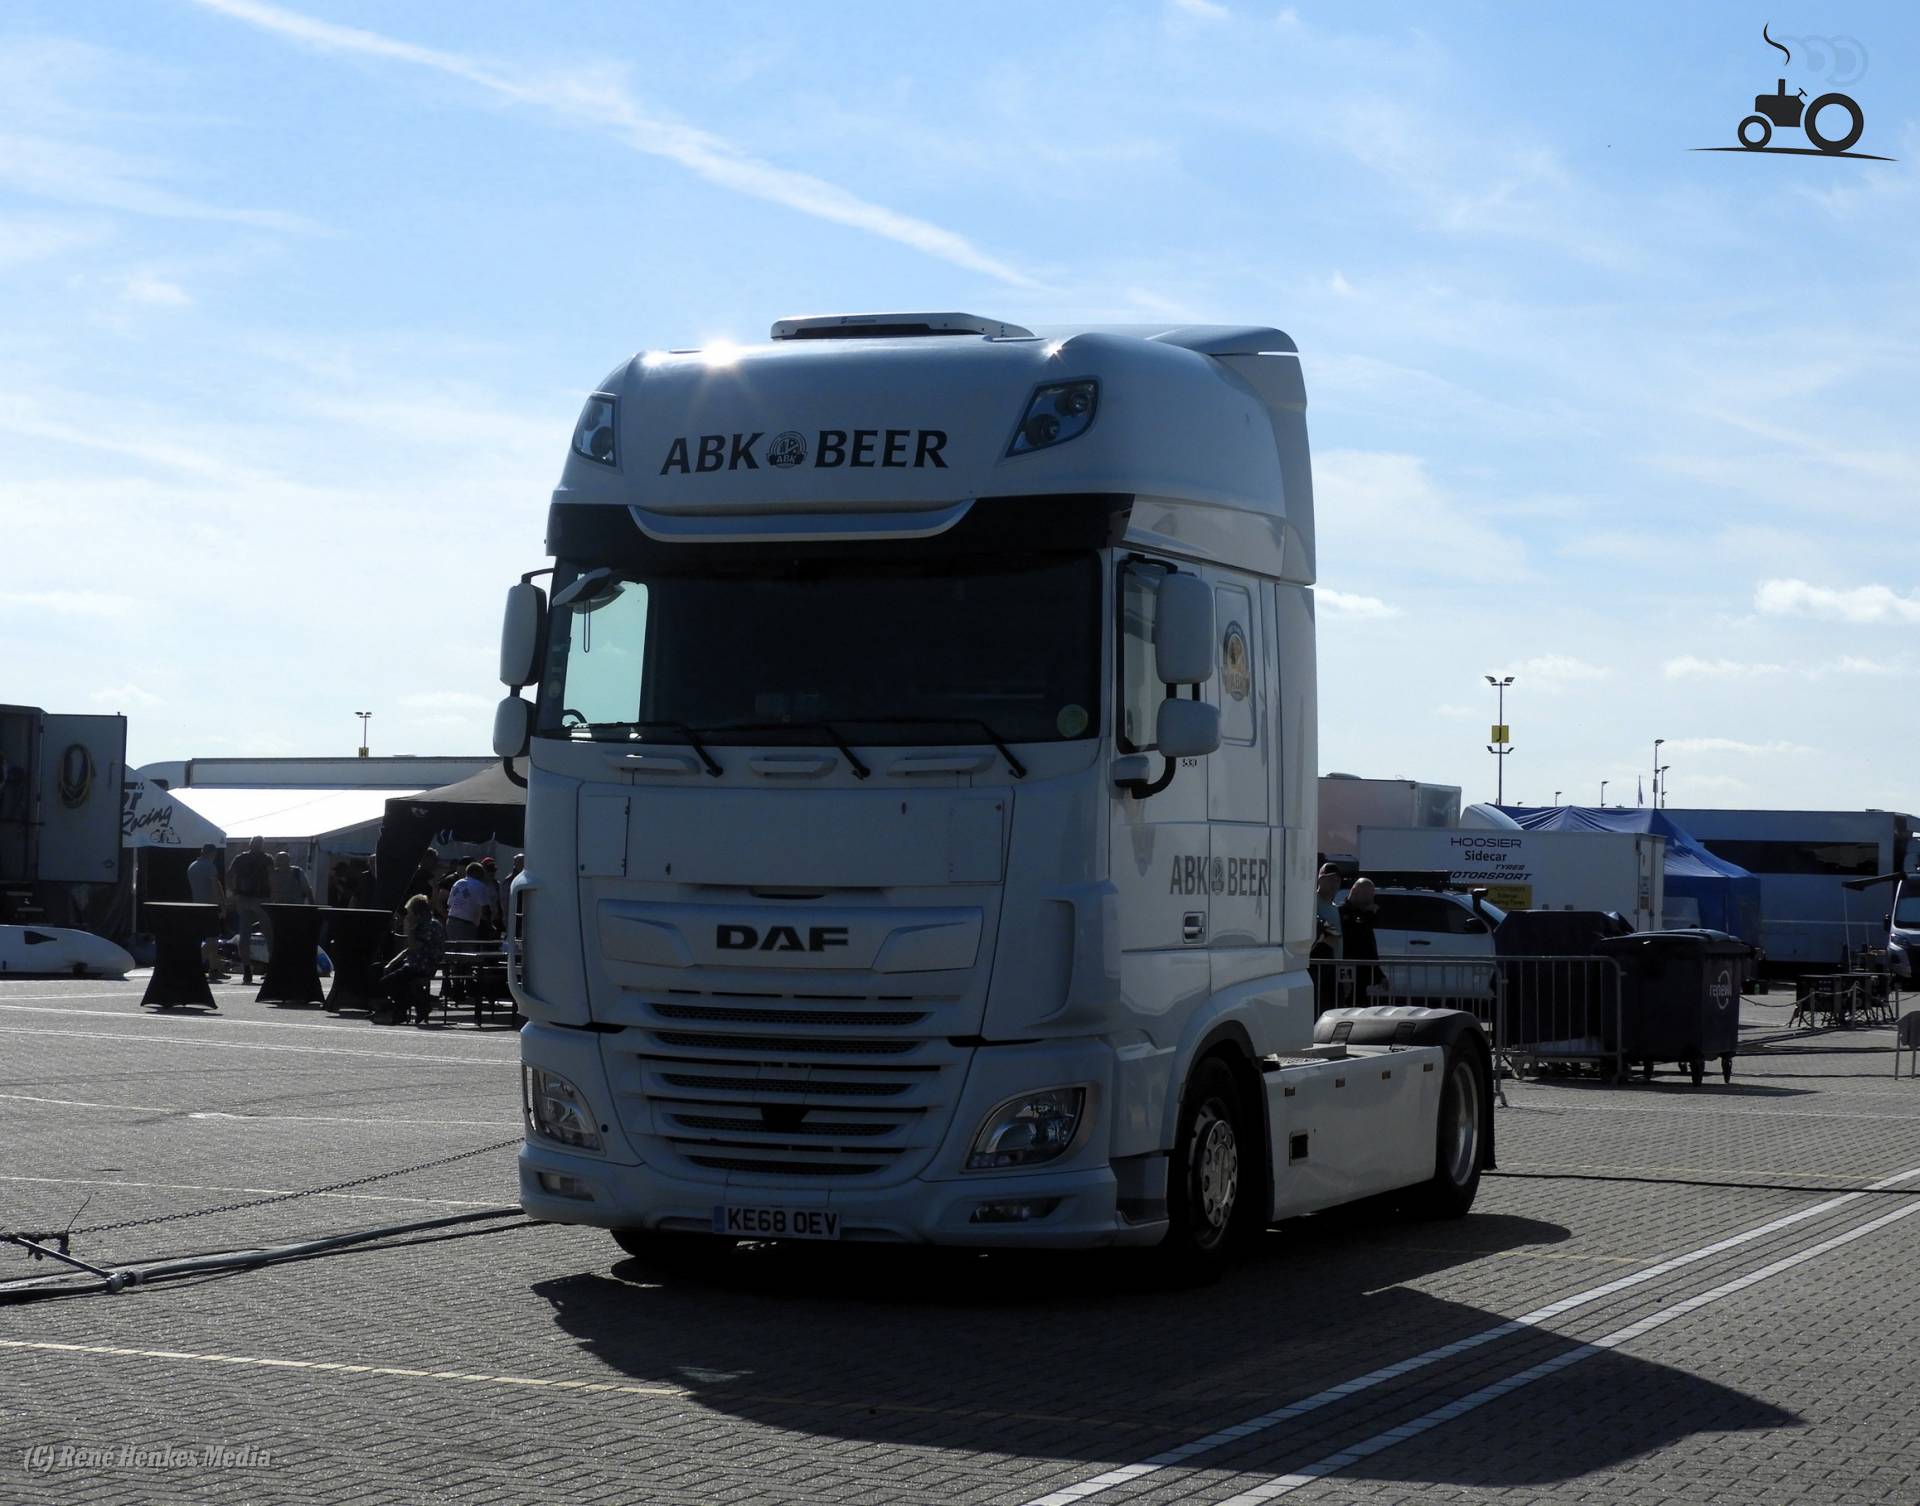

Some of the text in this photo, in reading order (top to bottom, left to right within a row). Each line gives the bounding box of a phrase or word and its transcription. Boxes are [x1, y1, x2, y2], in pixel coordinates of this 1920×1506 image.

[659, 430, 950, 475] ABK BEER
[1450, 837, 1522, 849] HOOSIER
[1464, 850, 1508, 862] Sidecar
[1169, 855, 1271, 897] ABK BEER
[716, 925, 849, 952] DAF
[727, 1207, 838, 1235] KE68 OEV
